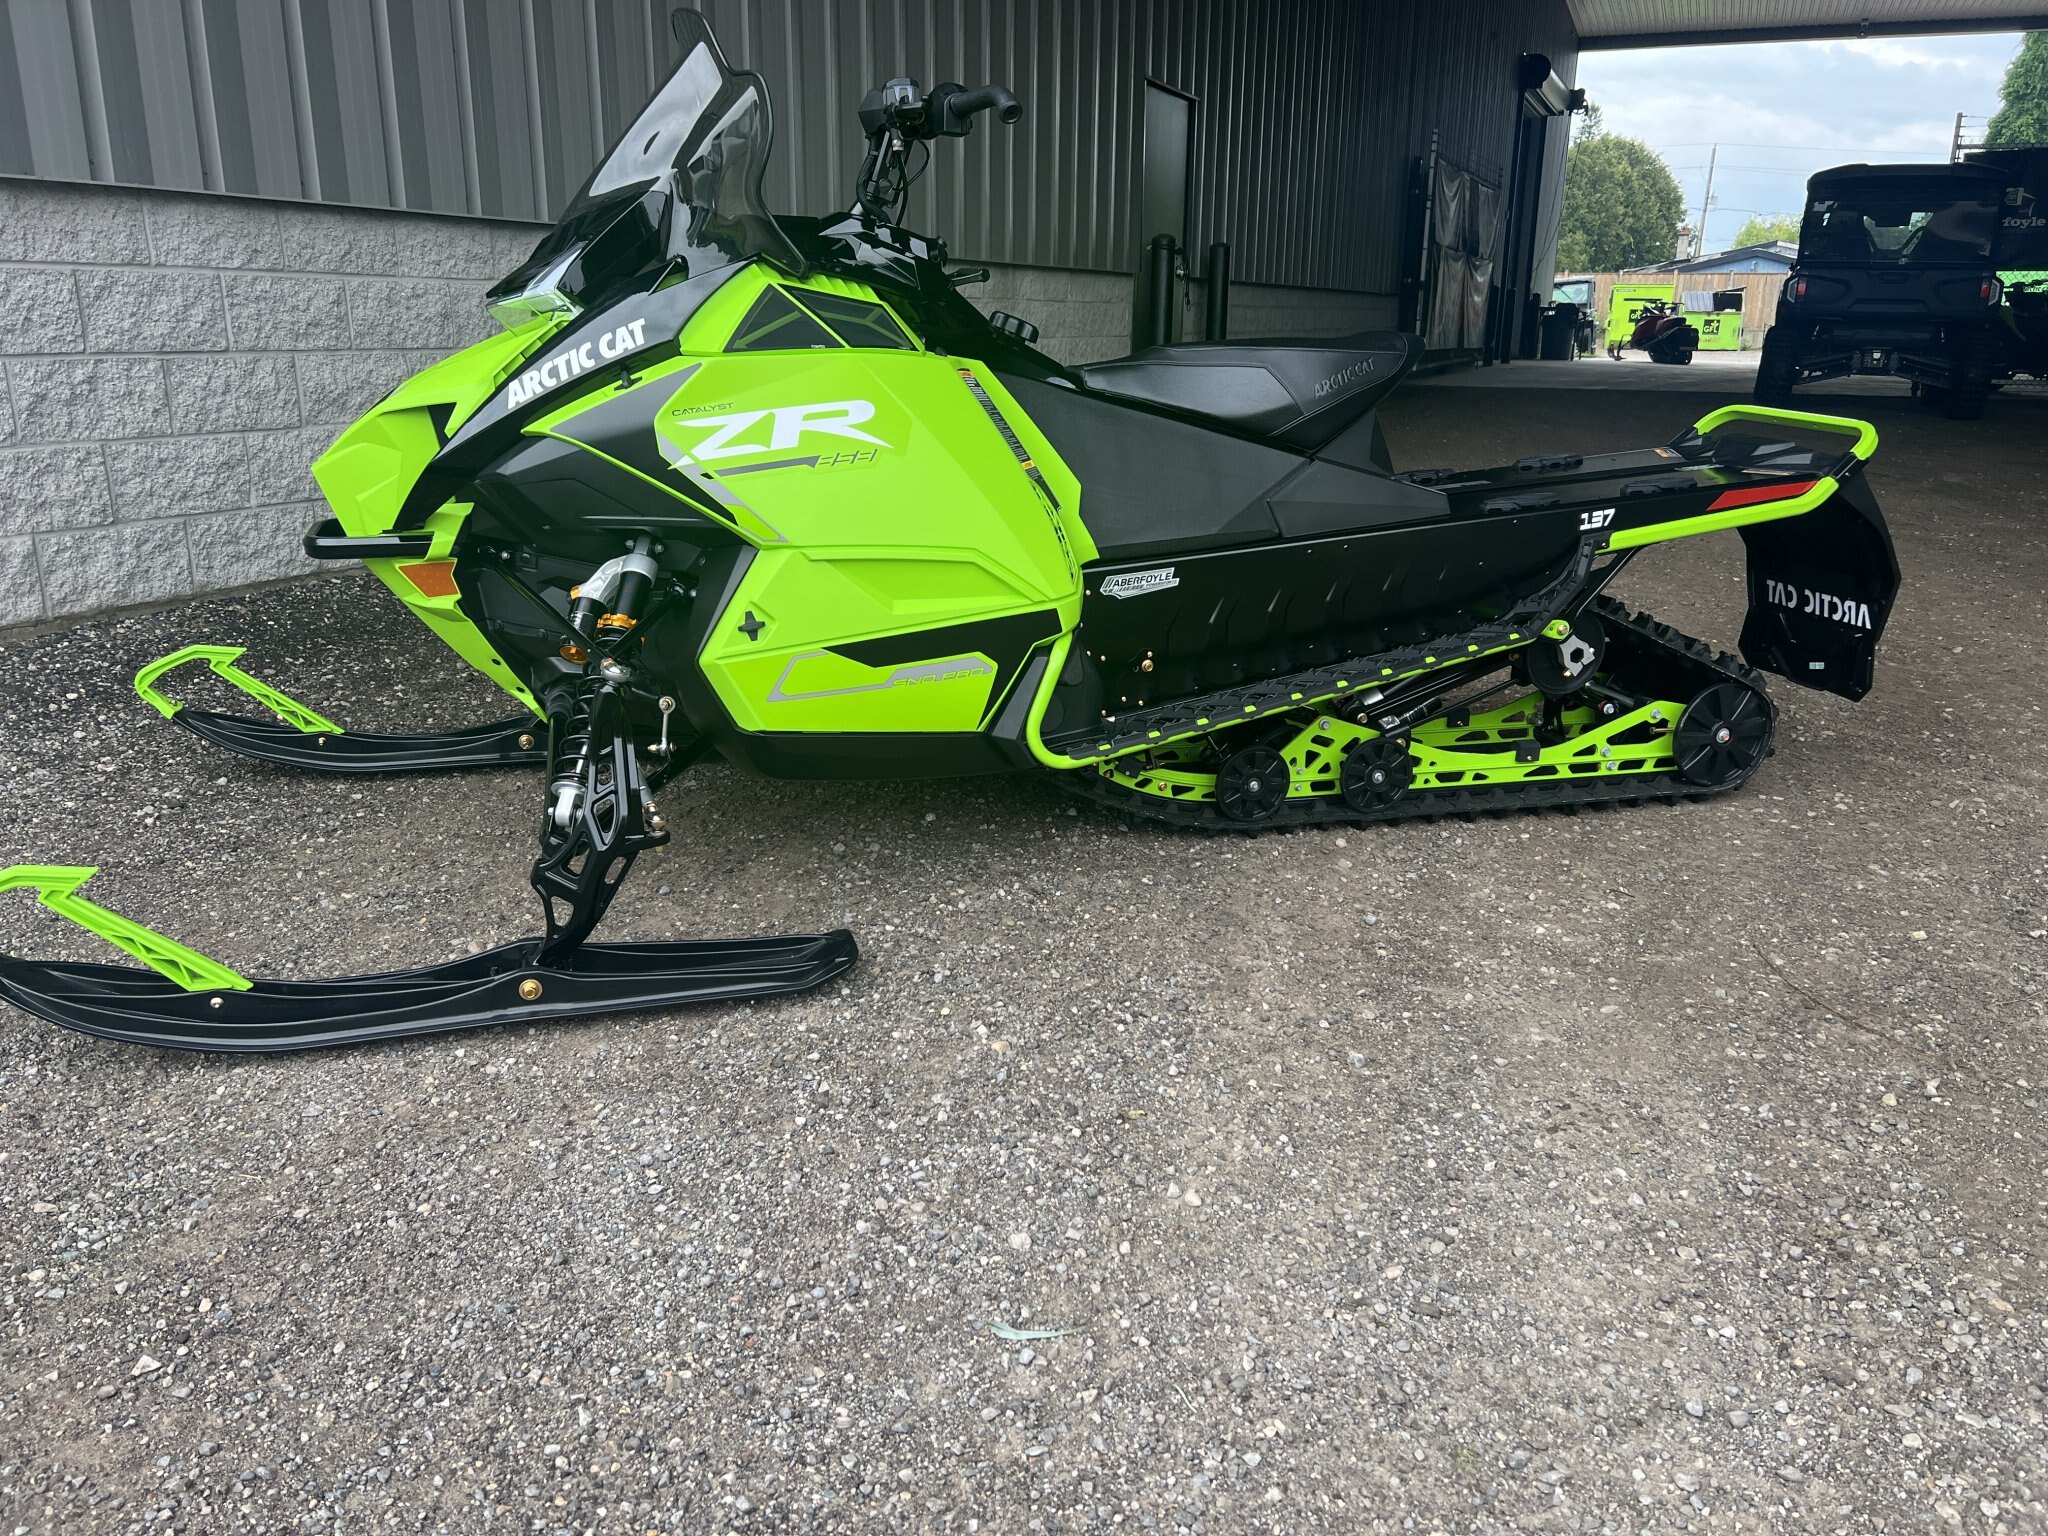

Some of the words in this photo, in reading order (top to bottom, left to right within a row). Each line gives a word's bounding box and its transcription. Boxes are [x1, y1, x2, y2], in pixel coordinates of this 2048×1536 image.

[507, 341, 595, 410] ARCTIC
[598, 317, 646, 360] CAT
[1313, 366, 1355, 400] ARCTIC
[1355, 356, 1375, 376] CAT
[671, 402, 735, 417] CATALYST
[667, 400, 894, 470] ZR
[1579, 507, 1616, 531] 137
[1112, 571, 1173, 588] ABERFOYLE
[893, 674, 937, 687] SNO
